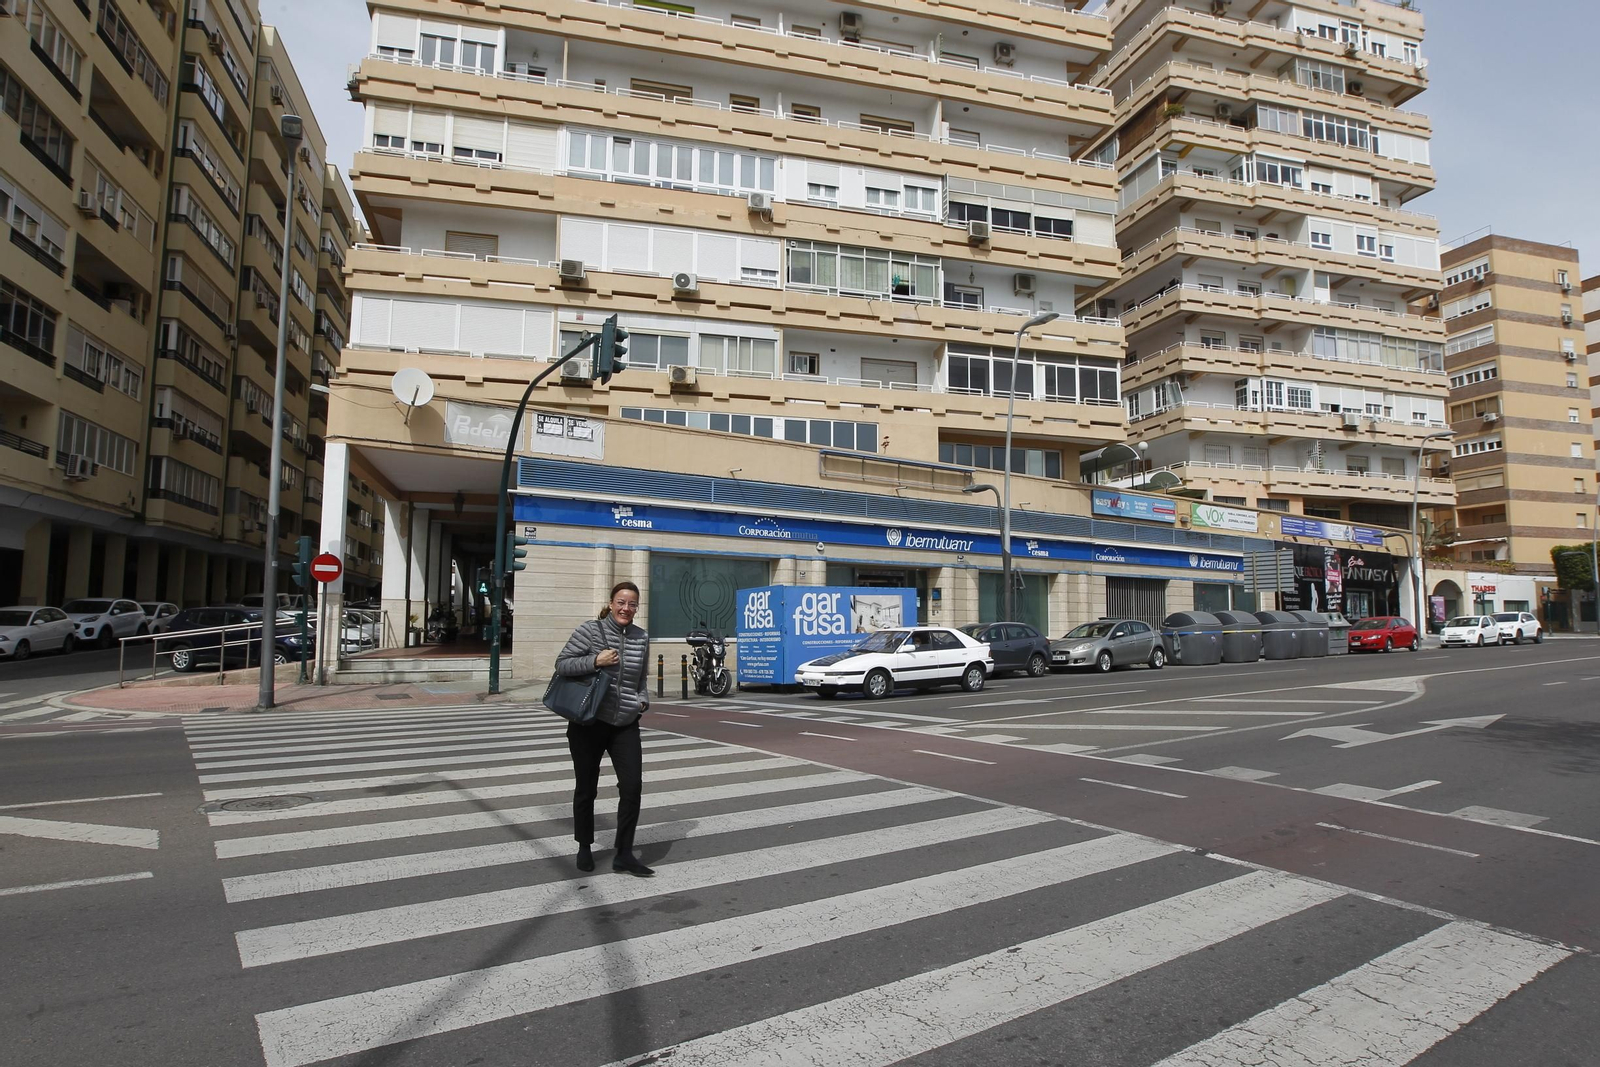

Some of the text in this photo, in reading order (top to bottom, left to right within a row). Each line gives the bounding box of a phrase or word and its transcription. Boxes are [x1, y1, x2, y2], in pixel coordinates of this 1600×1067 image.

[544, 416, 563, 424] ALQUILA
[621, 518, 652, 529] cesma
[1205, 508, 1225, 523] VOX
[905, 533, 974, 551] ibermutuamur
[1341, 567, 1389, 582] FANTASY
[748, 590, 771, 617] gar
[801, 592, 841, 622] gar
[743, 604, 773, 629] fusa
[792, 605, 846, 636] fusa
